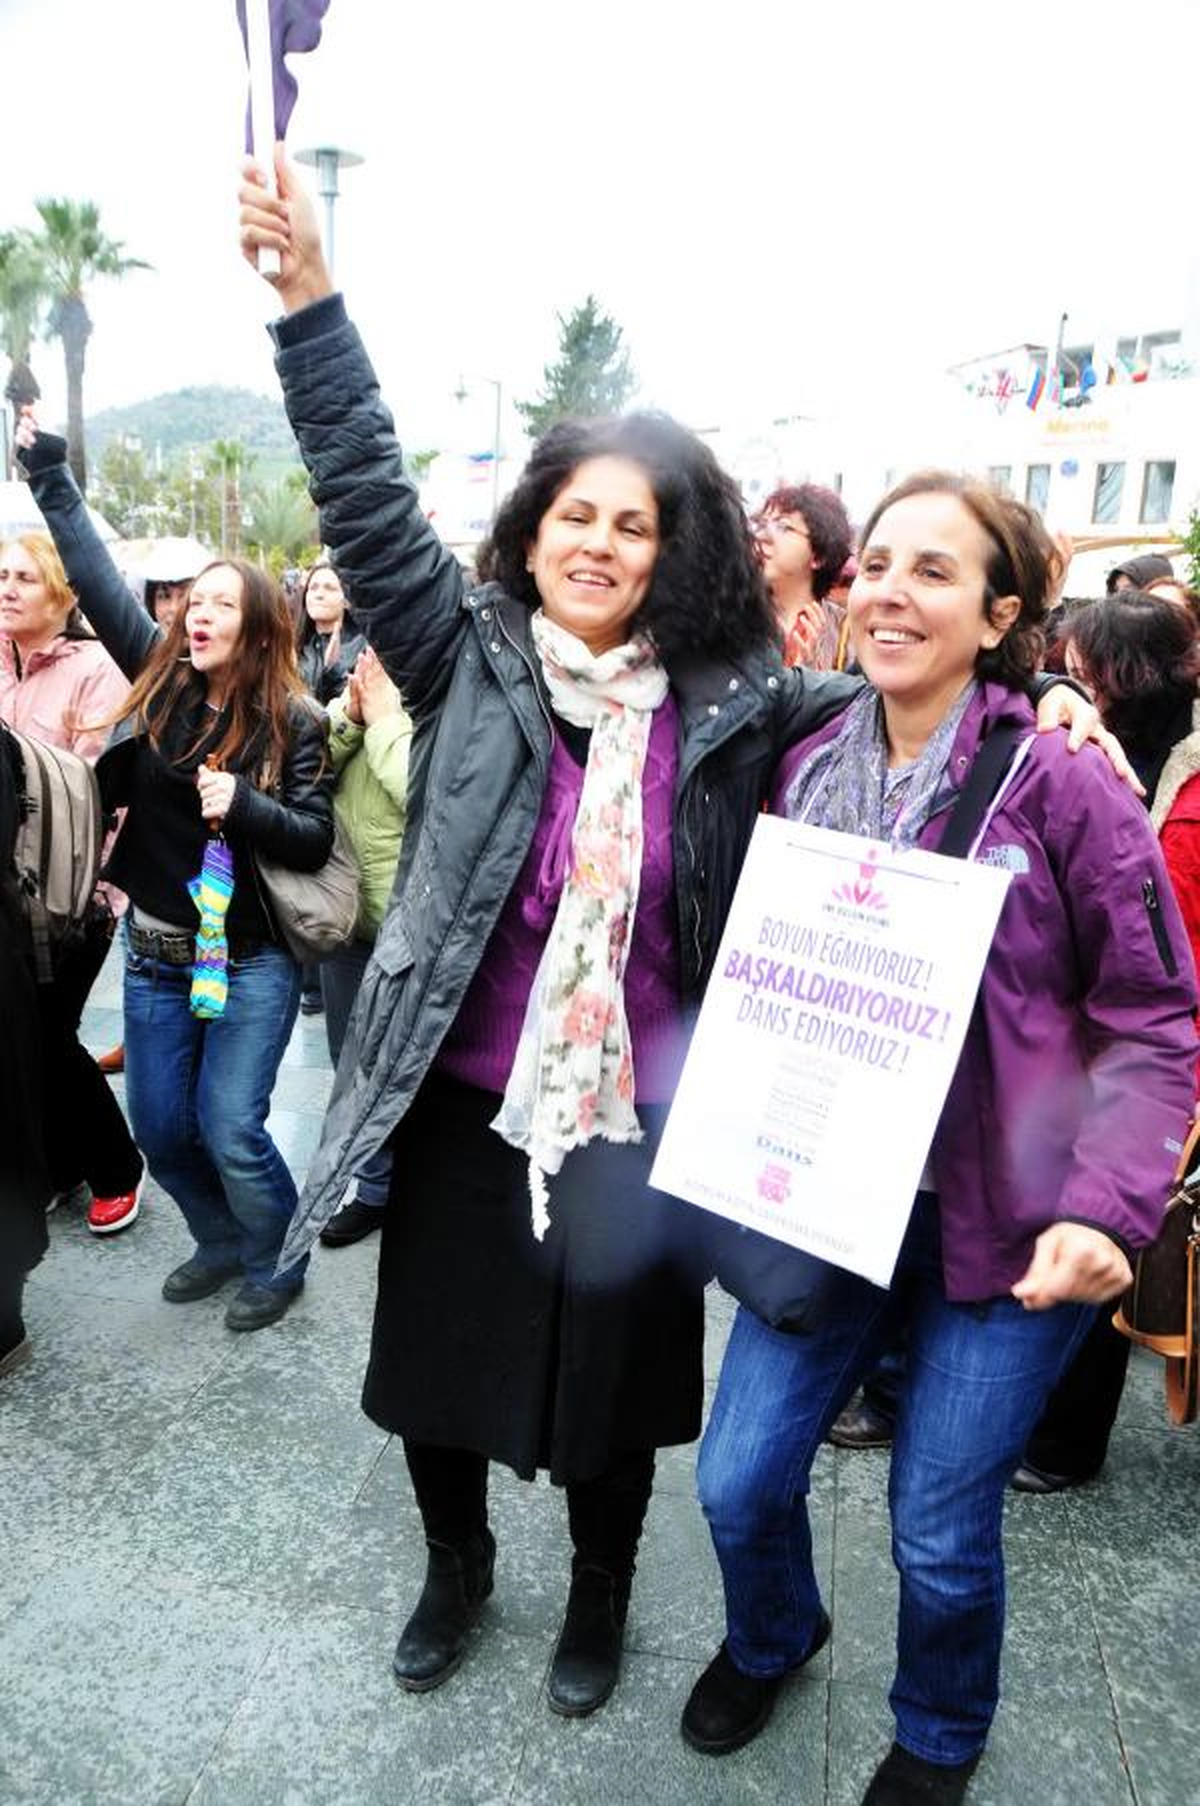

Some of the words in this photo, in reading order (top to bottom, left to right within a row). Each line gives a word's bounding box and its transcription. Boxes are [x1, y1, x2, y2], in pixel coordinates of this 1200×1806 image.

[758, 916, 818, 959] BOYUN
[723, 949, 951, 1043] BAŞKALDIRIYORUZ!
[737, 993, 792, 1036] DANS
[794, 1010, 910, 1073] EDİYORUZ!
